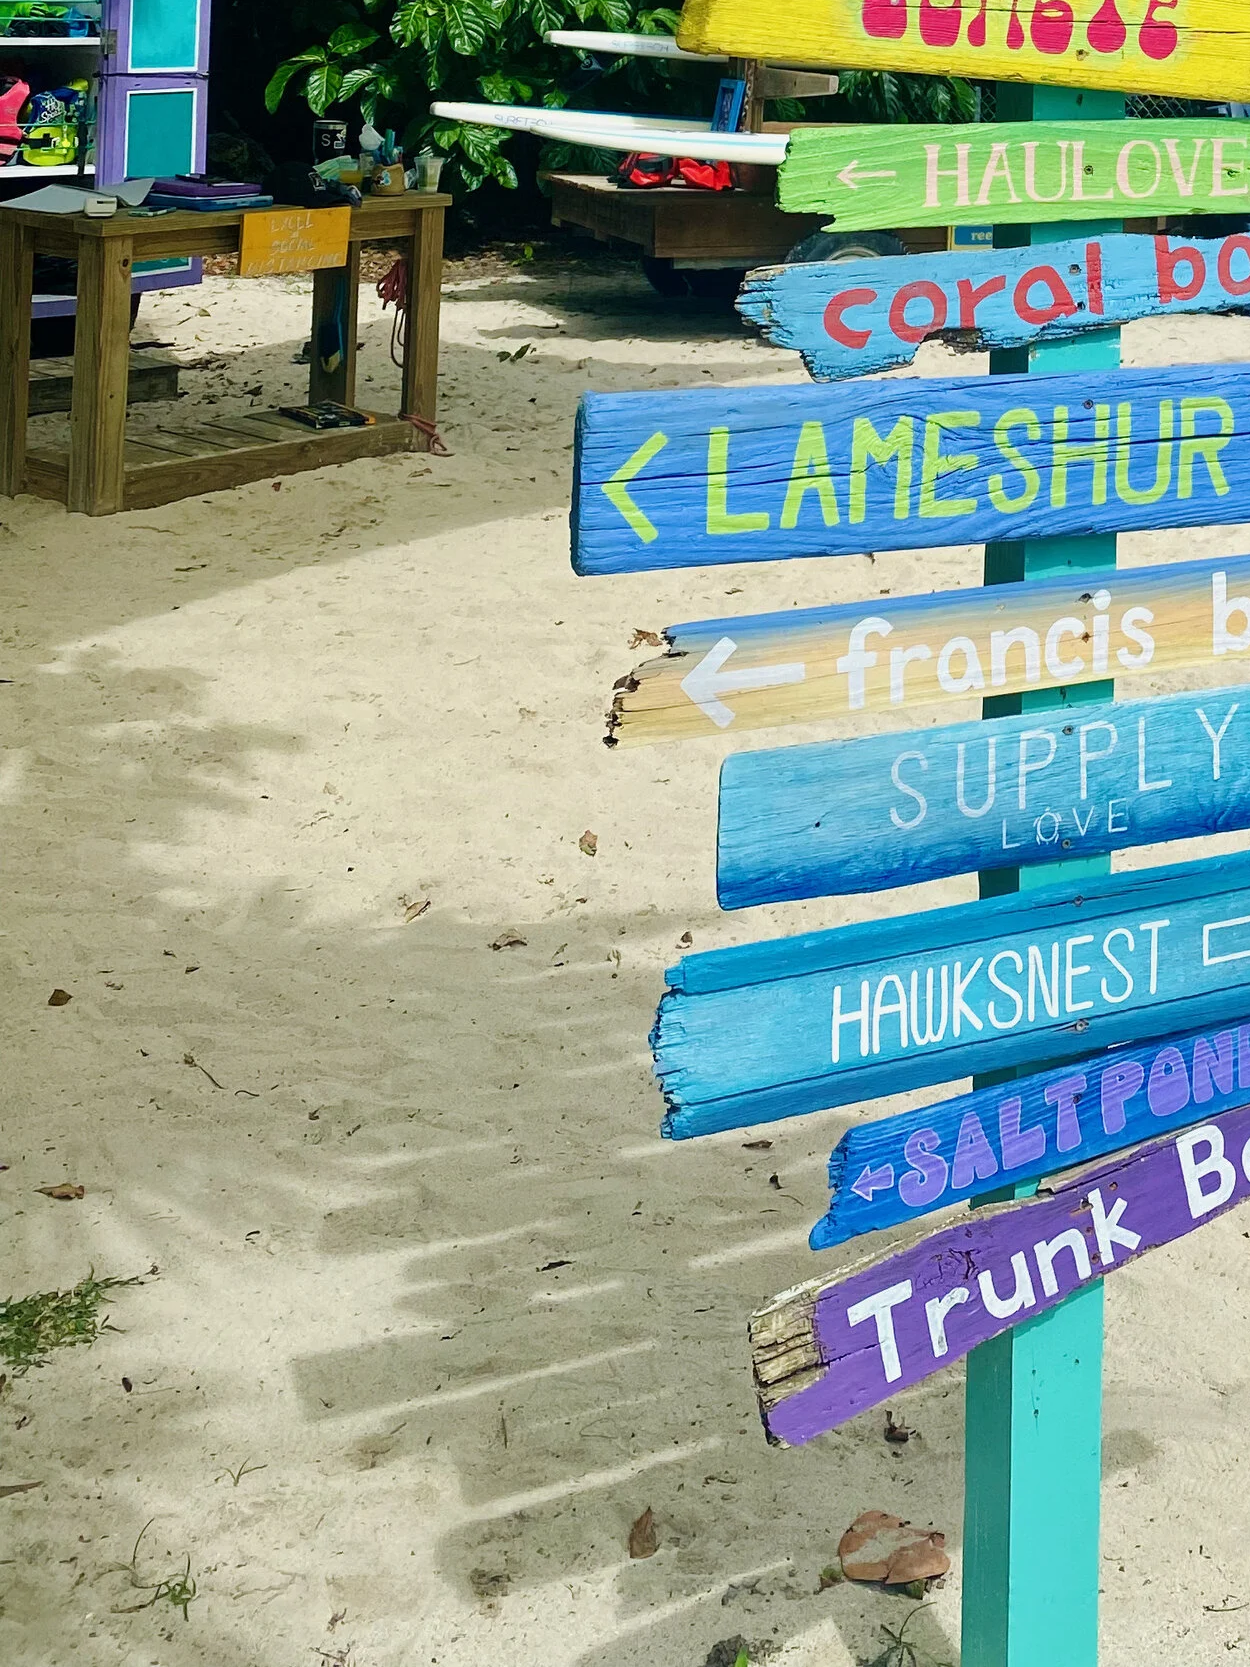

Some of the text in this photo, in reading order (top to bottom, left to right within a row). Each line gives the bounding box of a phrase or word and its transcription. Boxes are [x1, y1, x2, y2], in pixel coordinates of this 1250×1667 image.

[822, 240, 1105, 349] coral
[705, 394, 1236, 536] LAMESHUR
[836, 588, 1156, 710] francis
[889, 702, 1240, 830] SUPPLY
[1001, 798, 1129, 850] LOVE
[830, 919, 1172, 1064] HAWKSNEST
[847, 1188, 1143, 1384] Trunk
